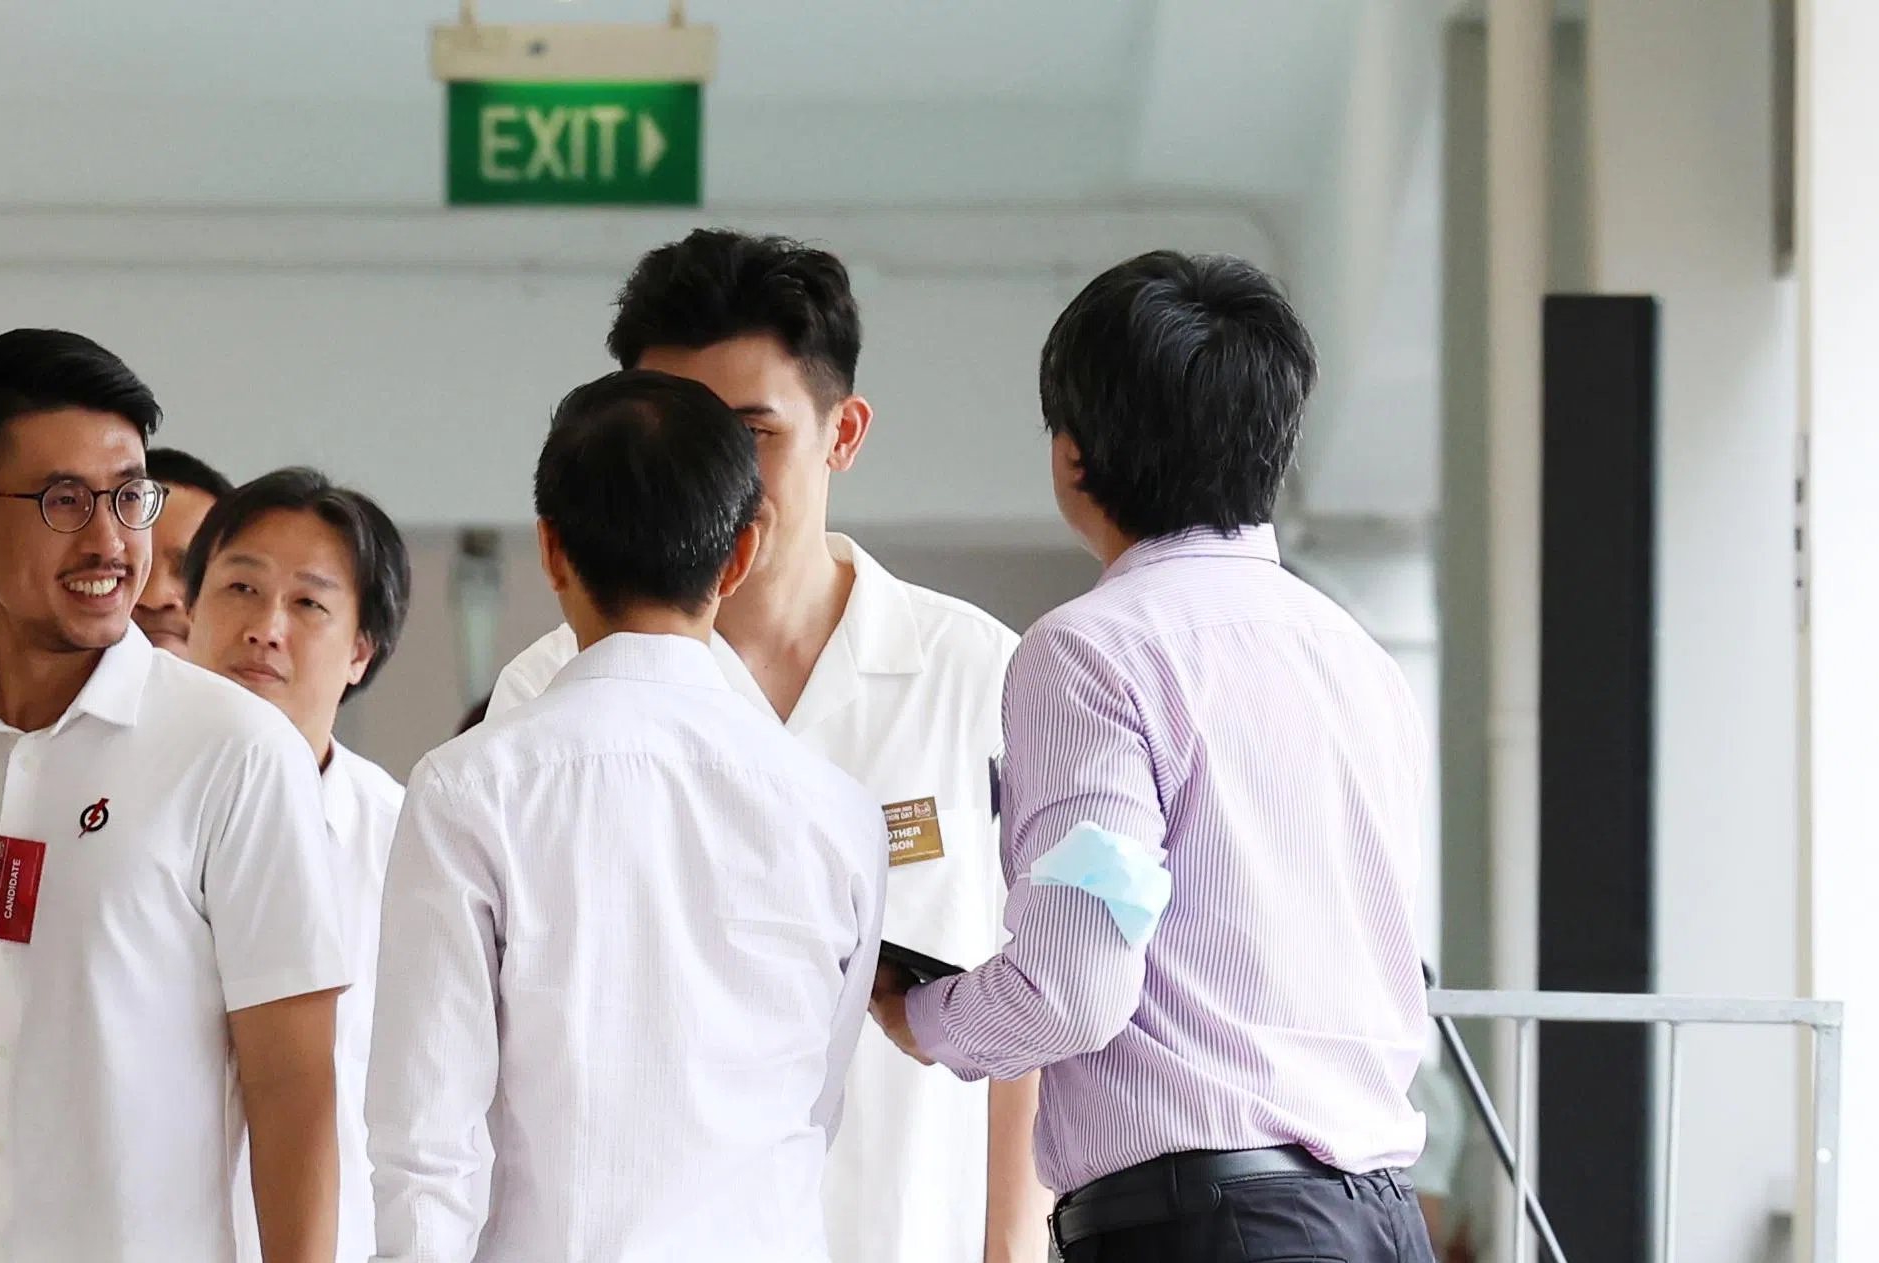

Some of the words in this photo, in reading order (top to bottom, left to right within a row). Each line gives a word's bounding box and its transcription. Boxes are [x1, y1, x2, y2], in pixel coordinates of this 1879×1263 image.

[480, 105, 629, 181] EXIT
[889, 839, 914, 852] SON
[4, 858, 21, 919] CANDIDATE
